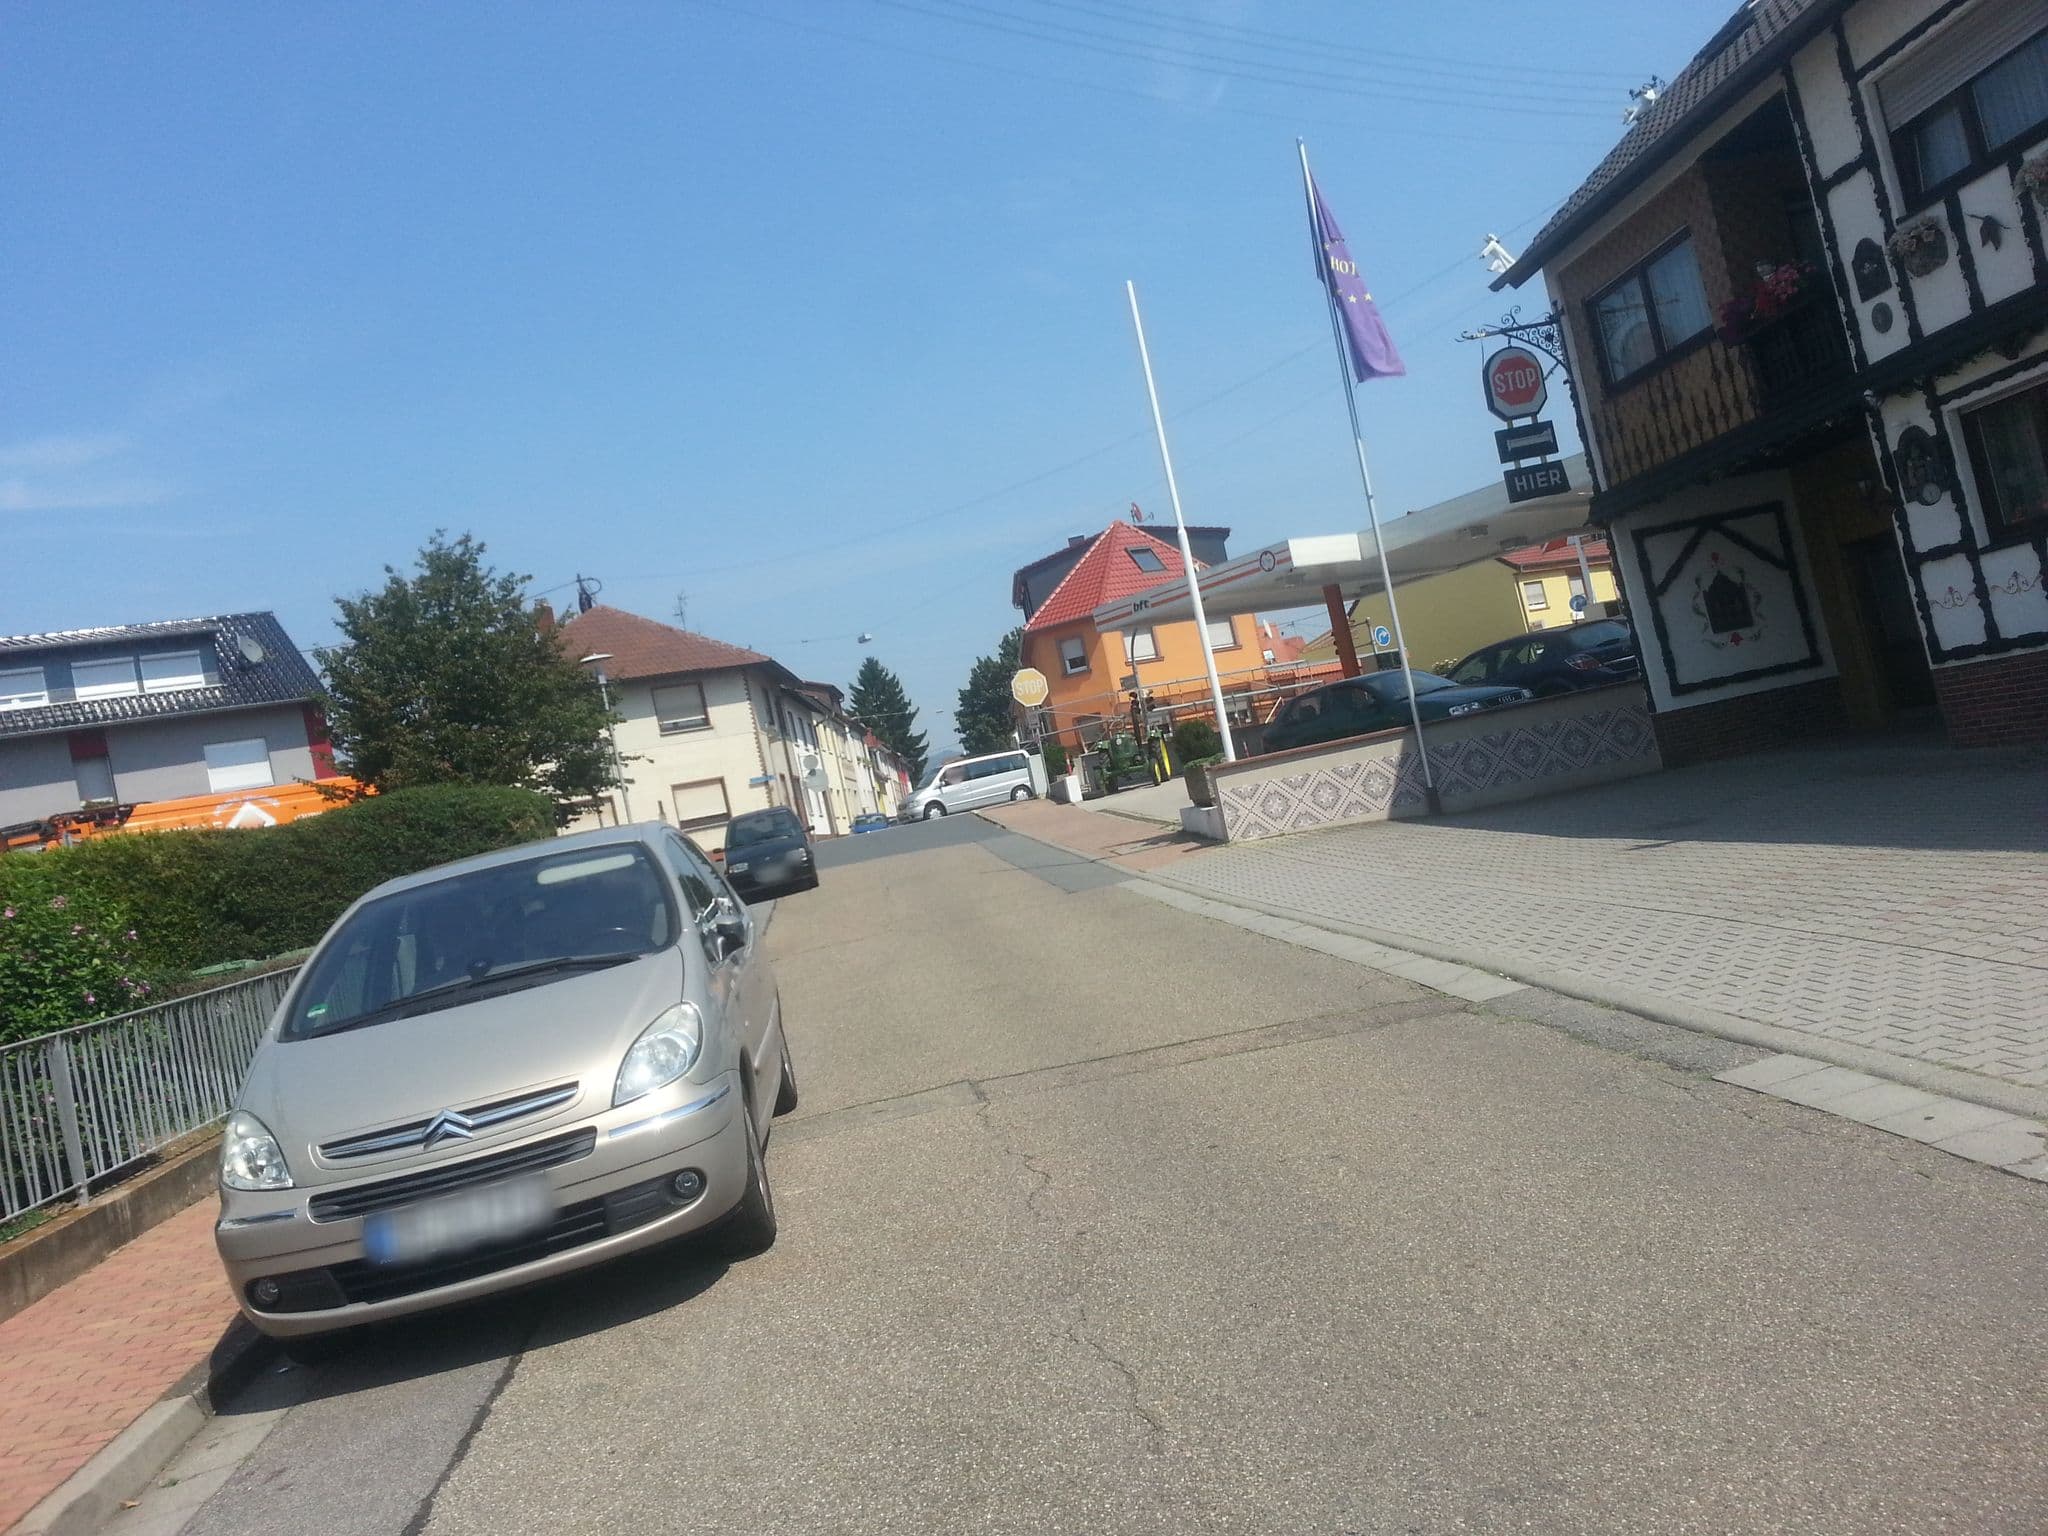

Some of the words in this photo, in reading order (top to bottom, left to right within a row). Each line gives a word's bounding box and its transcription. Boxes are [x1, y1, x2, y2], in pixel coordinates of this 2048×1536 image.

[1494, 367, 1537, 393] STOP
[1514, 469, 1563, 493] HIER
[1133, 599, 1150, 613] bft
[1015, 678, 1043, 697] STOP
